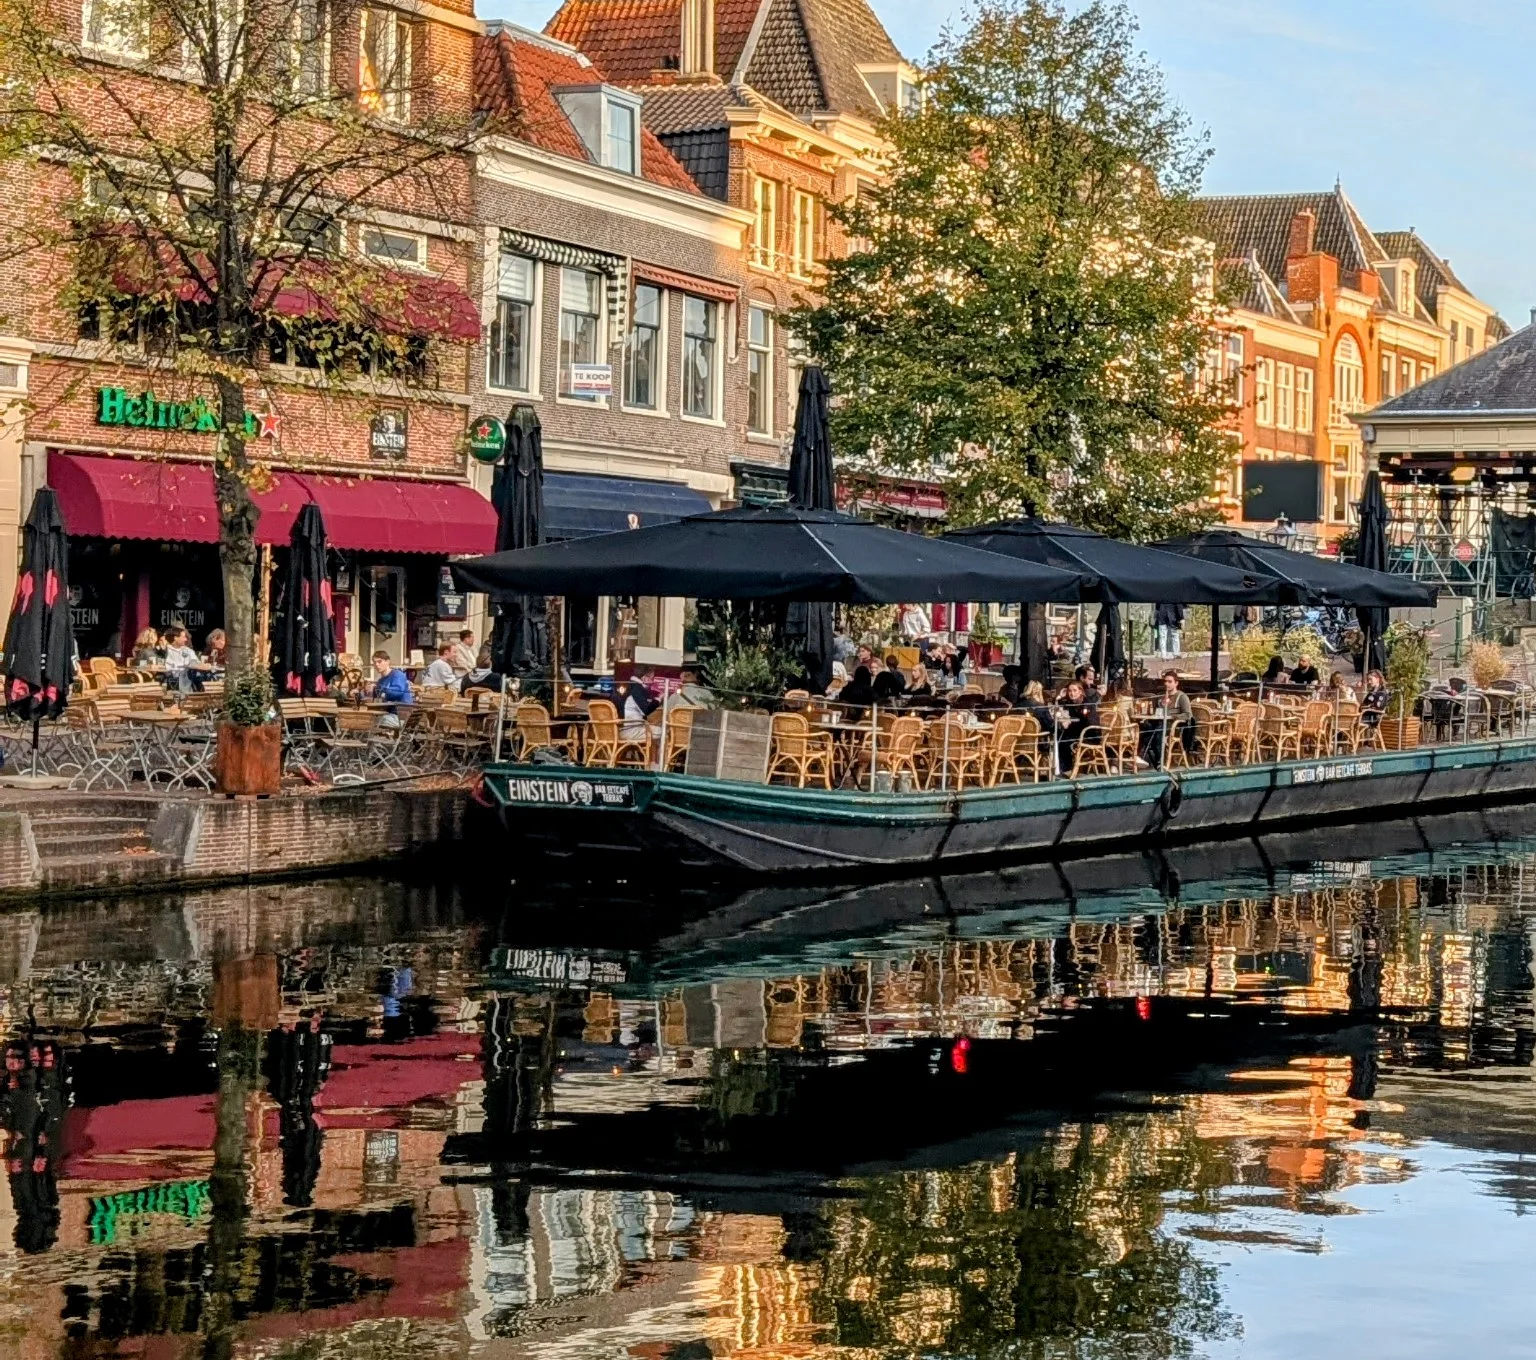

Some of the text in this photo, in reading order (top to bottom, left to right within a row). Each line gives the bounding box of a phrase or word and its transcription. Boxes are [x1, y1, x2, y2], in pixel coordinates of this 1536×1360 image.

[586, 373, 611, 381] KOOP
[160, 609, 205, 627] EINSTEIN
[508, 779, 569, 803] EINSTEIN
